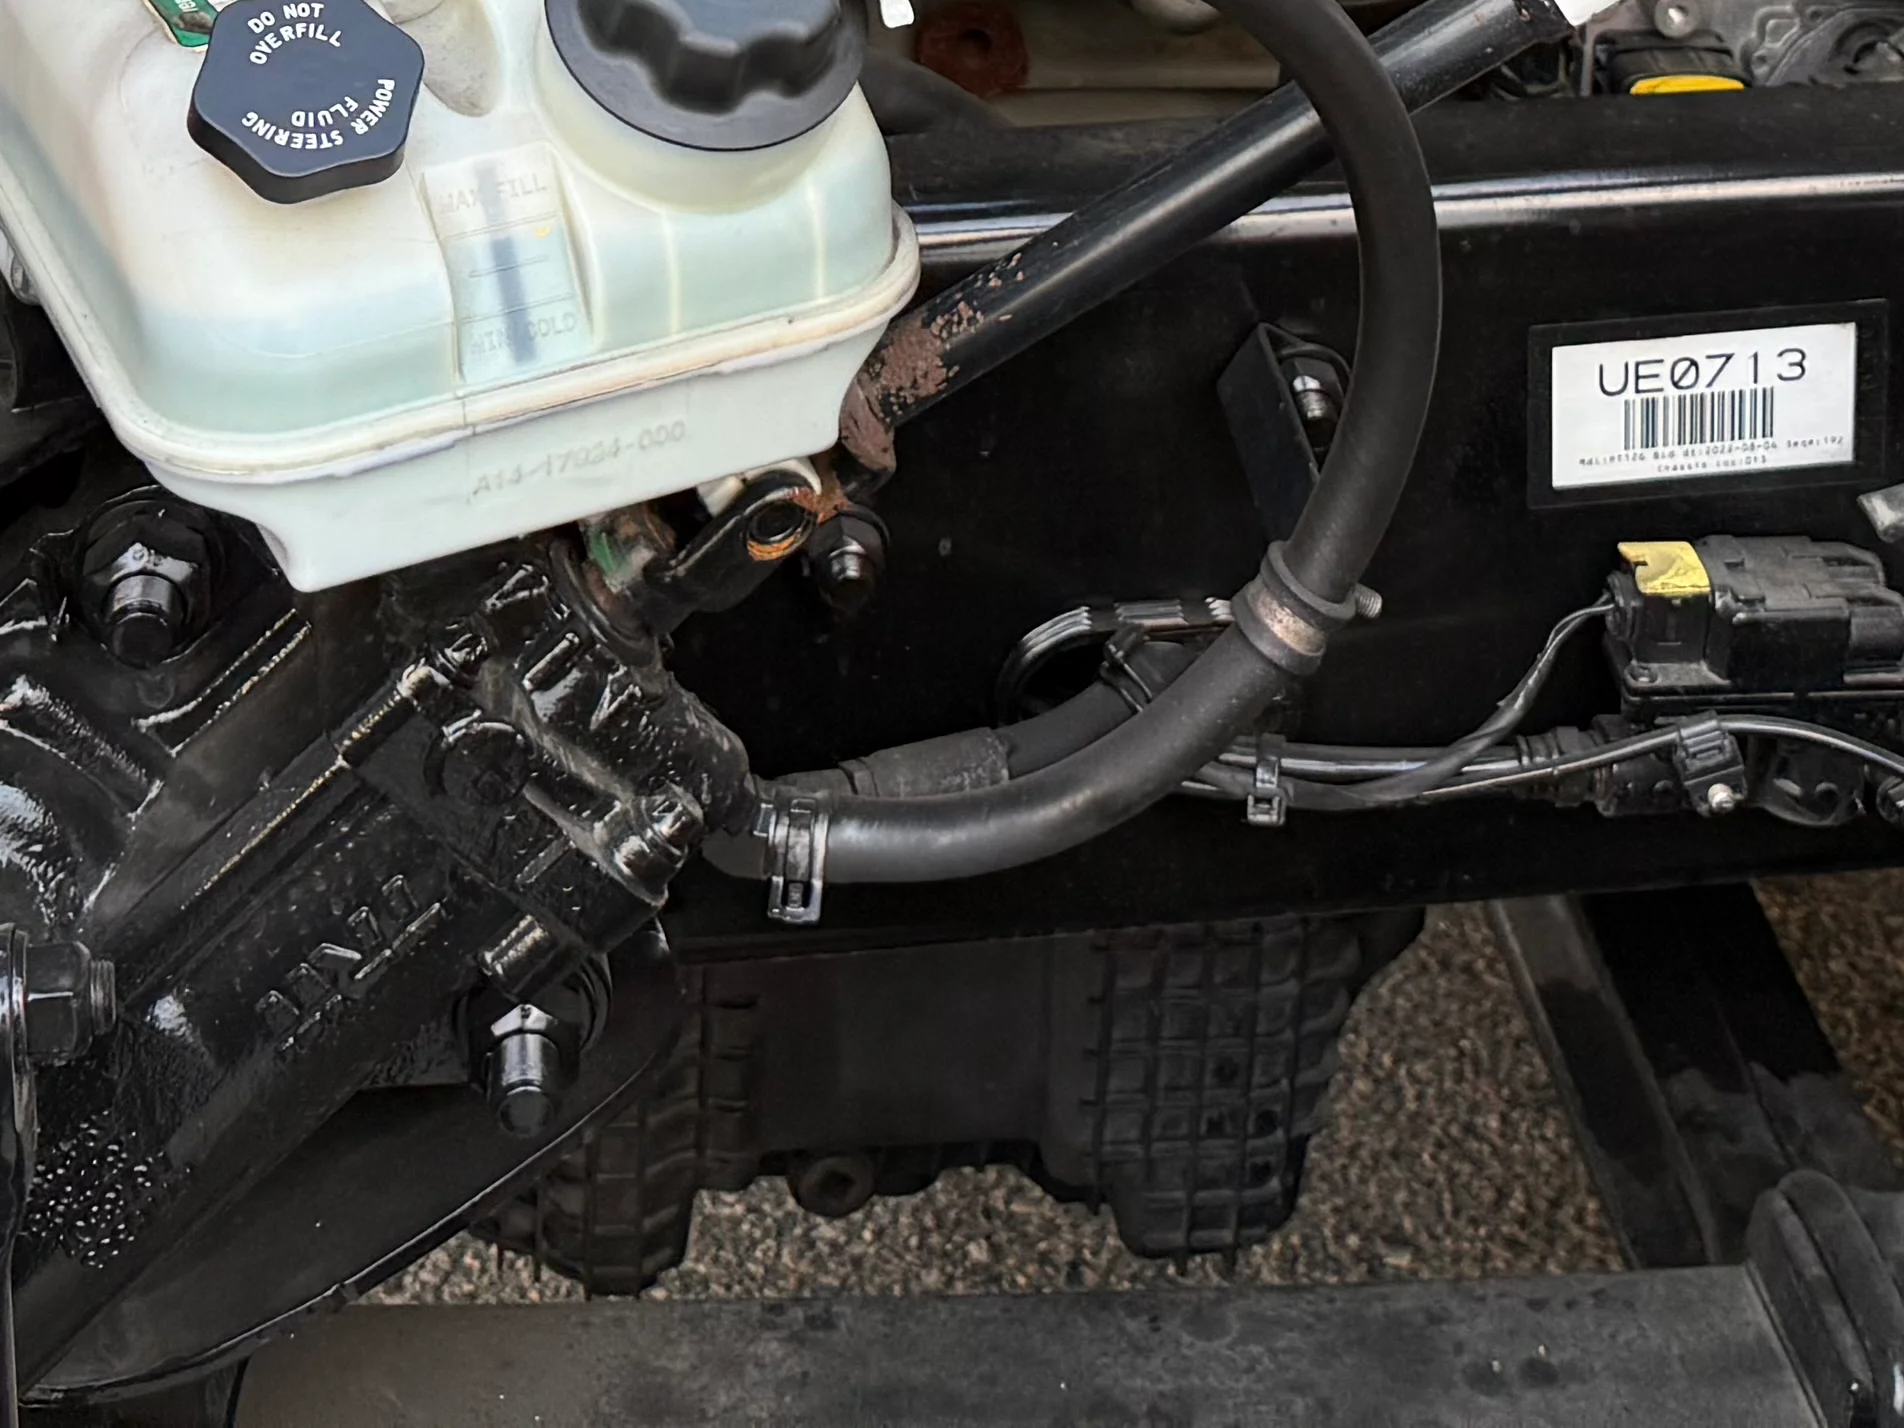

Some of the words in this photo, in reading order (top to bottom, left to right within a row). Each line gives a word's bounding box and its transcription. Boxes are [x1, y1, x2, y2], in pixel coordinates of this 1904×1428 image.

[247, 9, 276, 35] DO
[283, 0, 325, 19] NOT
[249, 21, 344, 66] OVERFILL
[291, 95, 360, 128] FLUID
[353, 78, 396, 137] POWER
[241, 110, 345, 150] STEERING
[495, 174, 548, 205] FILL
[1598, 347, 1808, 397] UE0713
